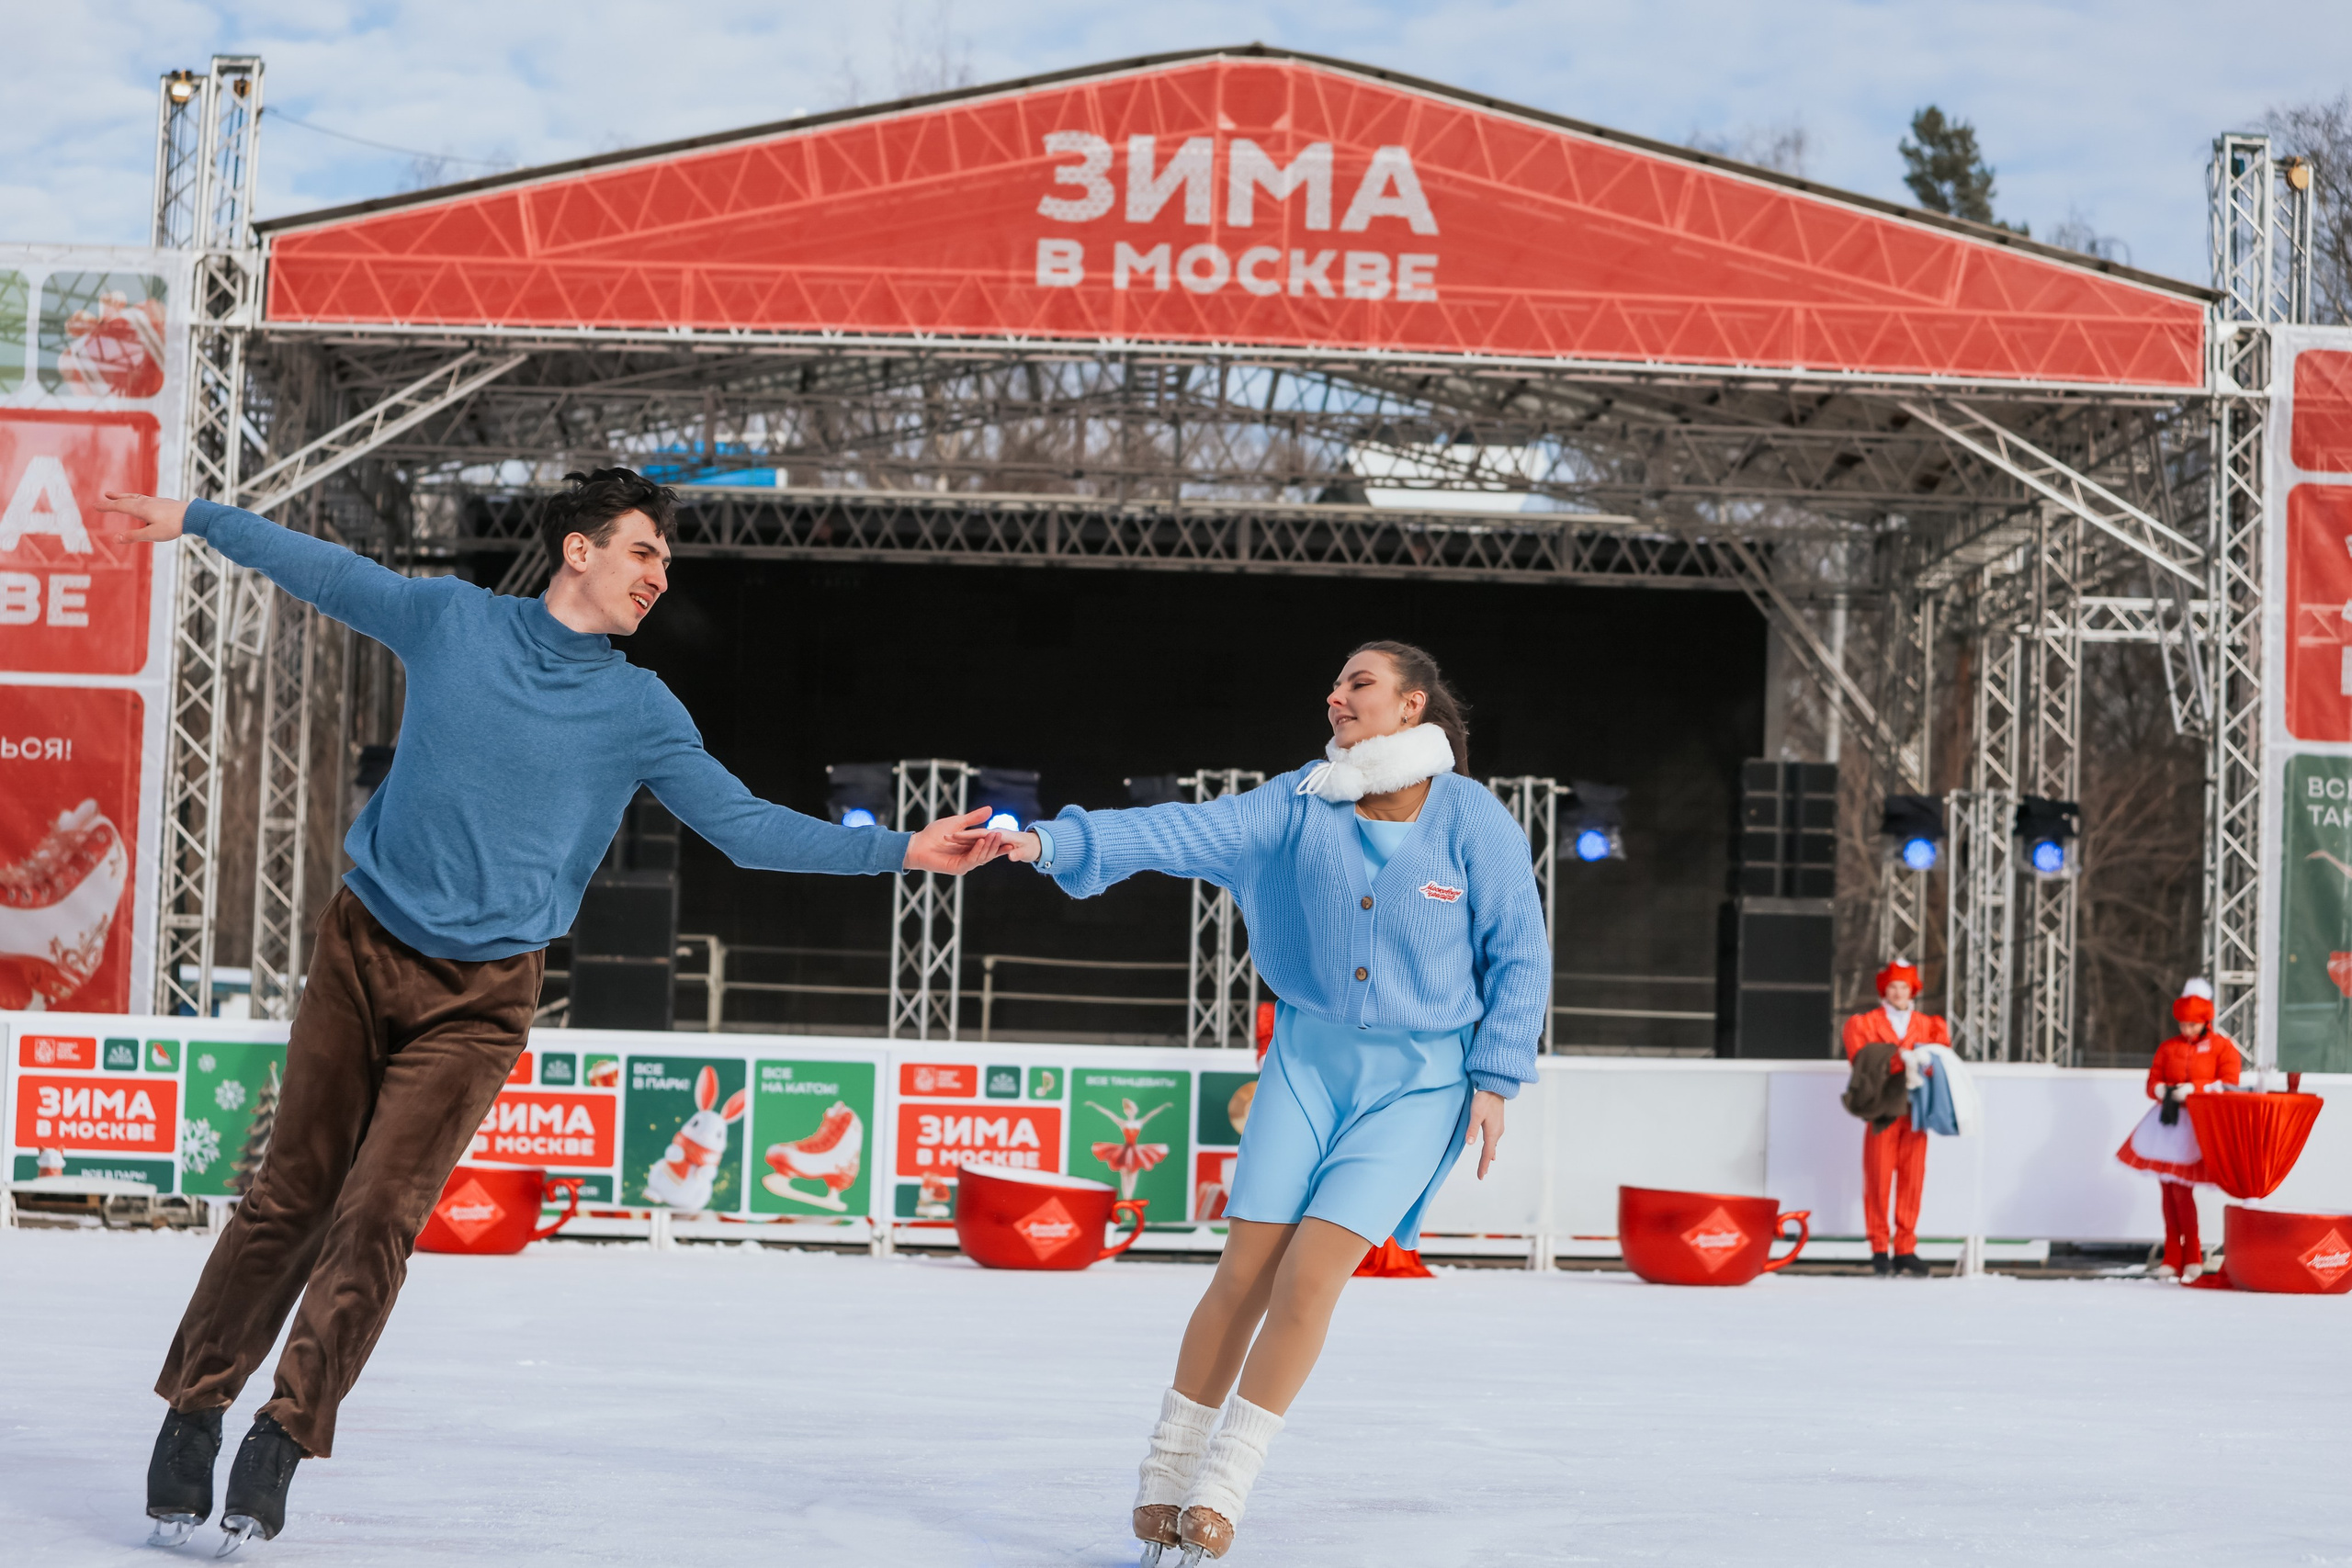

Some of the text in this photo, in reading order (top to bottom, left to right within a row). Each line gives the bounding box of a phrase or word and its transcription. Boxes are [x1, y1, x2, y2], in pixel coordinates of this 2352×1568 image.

[1036, 130, 1440, 236] ЗИМА
[1035, 238, 1440, 302] В МОСКВЕ
[632, 1063, 664, 1077] ВСЕ
[762, 1066, 793, 1080] ВСЕ
[37, 1086, 157, 1122] ЗИМА
[36, 1119, 157, 1143] В МОСКВЕ
[916, 1114, 1041, 1149] ЗИМА
[494, 1135, 595, 1156] МОСКВЕ
[916, 1148, 1041, 1168] В МОСКВЕ
